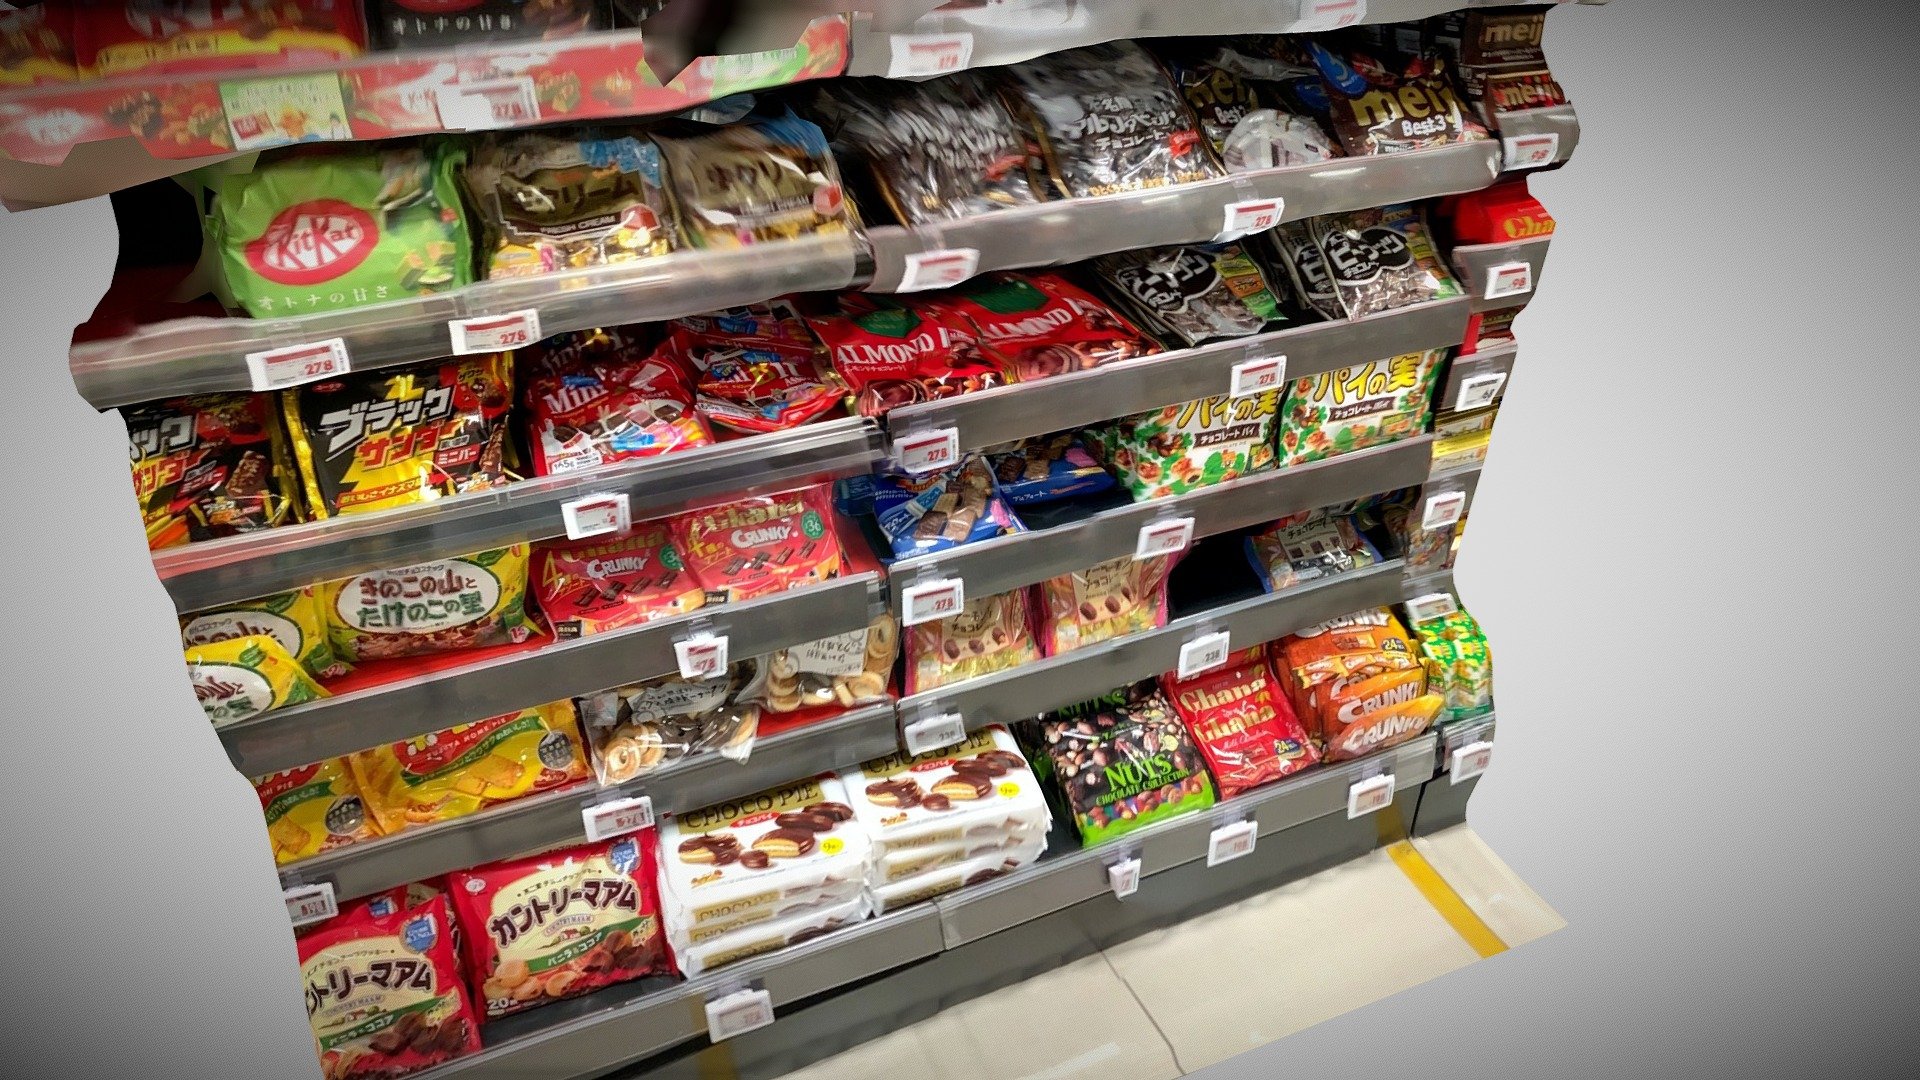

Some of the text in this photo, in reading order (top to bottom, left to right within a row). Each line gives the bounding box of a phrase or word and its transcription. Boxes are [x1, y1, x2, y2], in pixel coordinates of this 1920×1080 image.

[264, 212, 364, 270] KitKat
[258, 286, 389, 311] オトナの甘さ
[499, 330, 527, 345] 278
[837, 331, 936, 365] ALMOND
[304, 359, 333, 376] 278
[1312, 354, 1419, 405] パイの実
[319, 386, 452, 454] ブラック
[130, 414, 198, 461] ック
[356, 415, 465, 469] サンダー
[1200, 430, 1241, 445] チョコレート
[437, 448, 479, 466] ミニバー
[927, 447, 948, 463] 278
[731, 525, 791, 549] CRUNKY
[586, 556, 649, 579] CRUNKY
[359, 568, 479, 606] きのこの山と
[357, 589, 485, 628] たけのこの里
[1382, 639, 1398, 650] 24
[1180, 677, 1267, 712] Ghana
[463, 725, 490, 743] HOME
[1342, 715, 1427, 751] CRUNKY
[1103, 753, 1174, 789] NUTS
[684, 781, 819, 829] CHOCO PIE
[1095, 784, 1141, 807] CHOCOLATE
[489, 879, 638, 947] カントリーマアム
